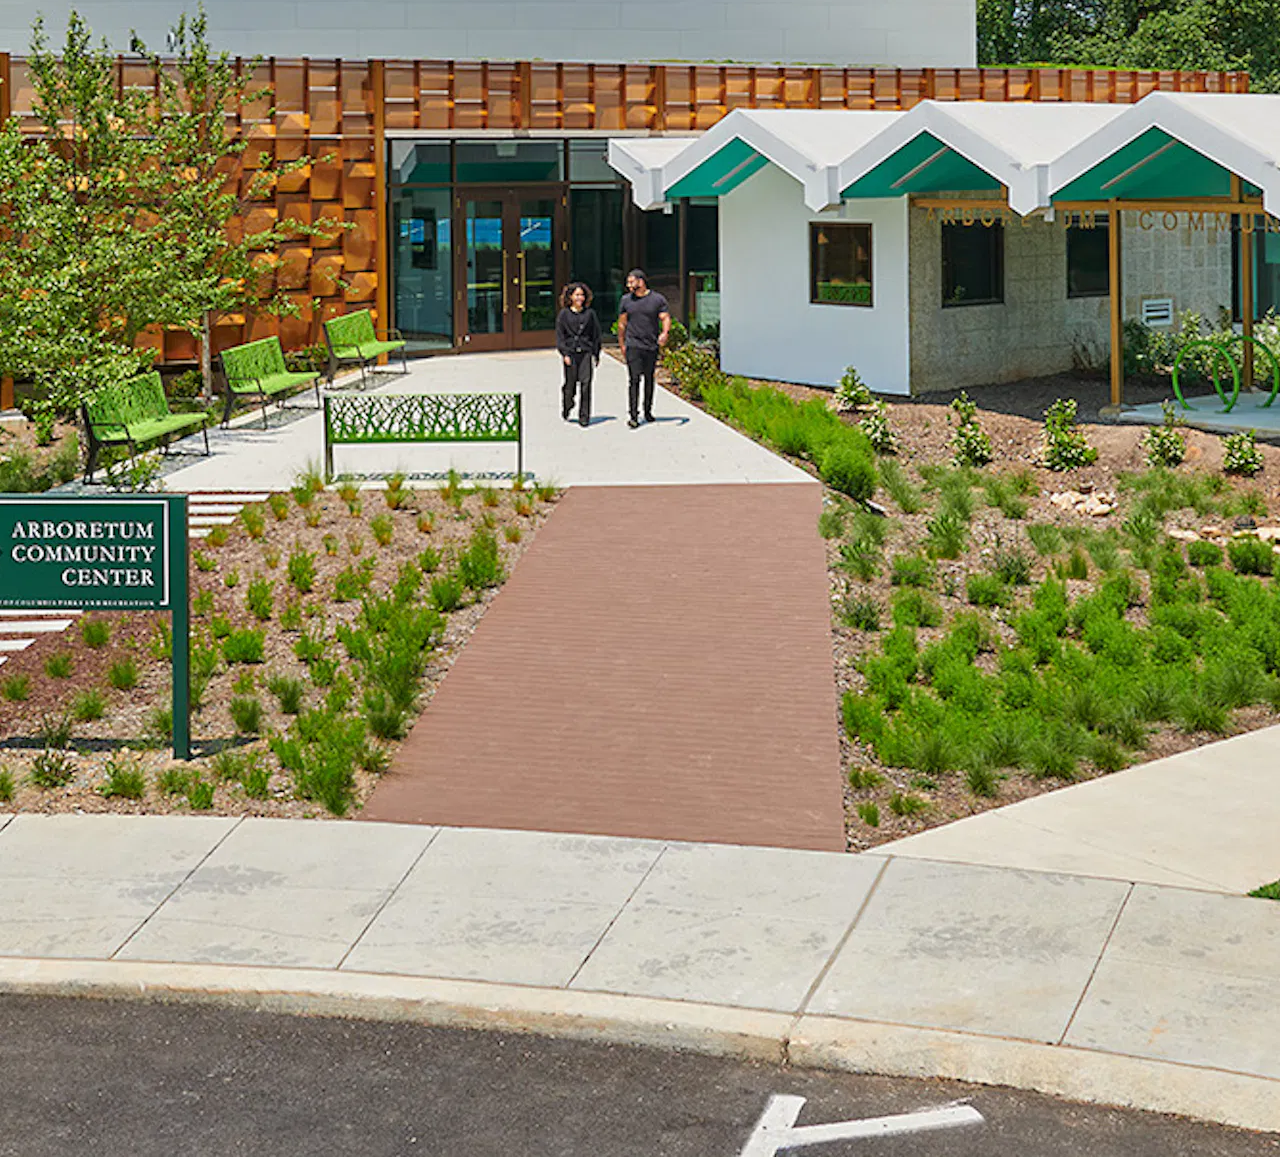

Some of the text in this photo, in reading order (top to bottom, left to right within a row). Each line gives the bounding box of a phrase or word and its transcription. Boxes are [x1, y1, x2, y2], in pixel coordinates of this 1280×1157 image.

[11, 521, 155, 540] ARBORETUM
[11, 545, 156, 563] COMMUNITY
[61, 568, 155, 587] CENTER
